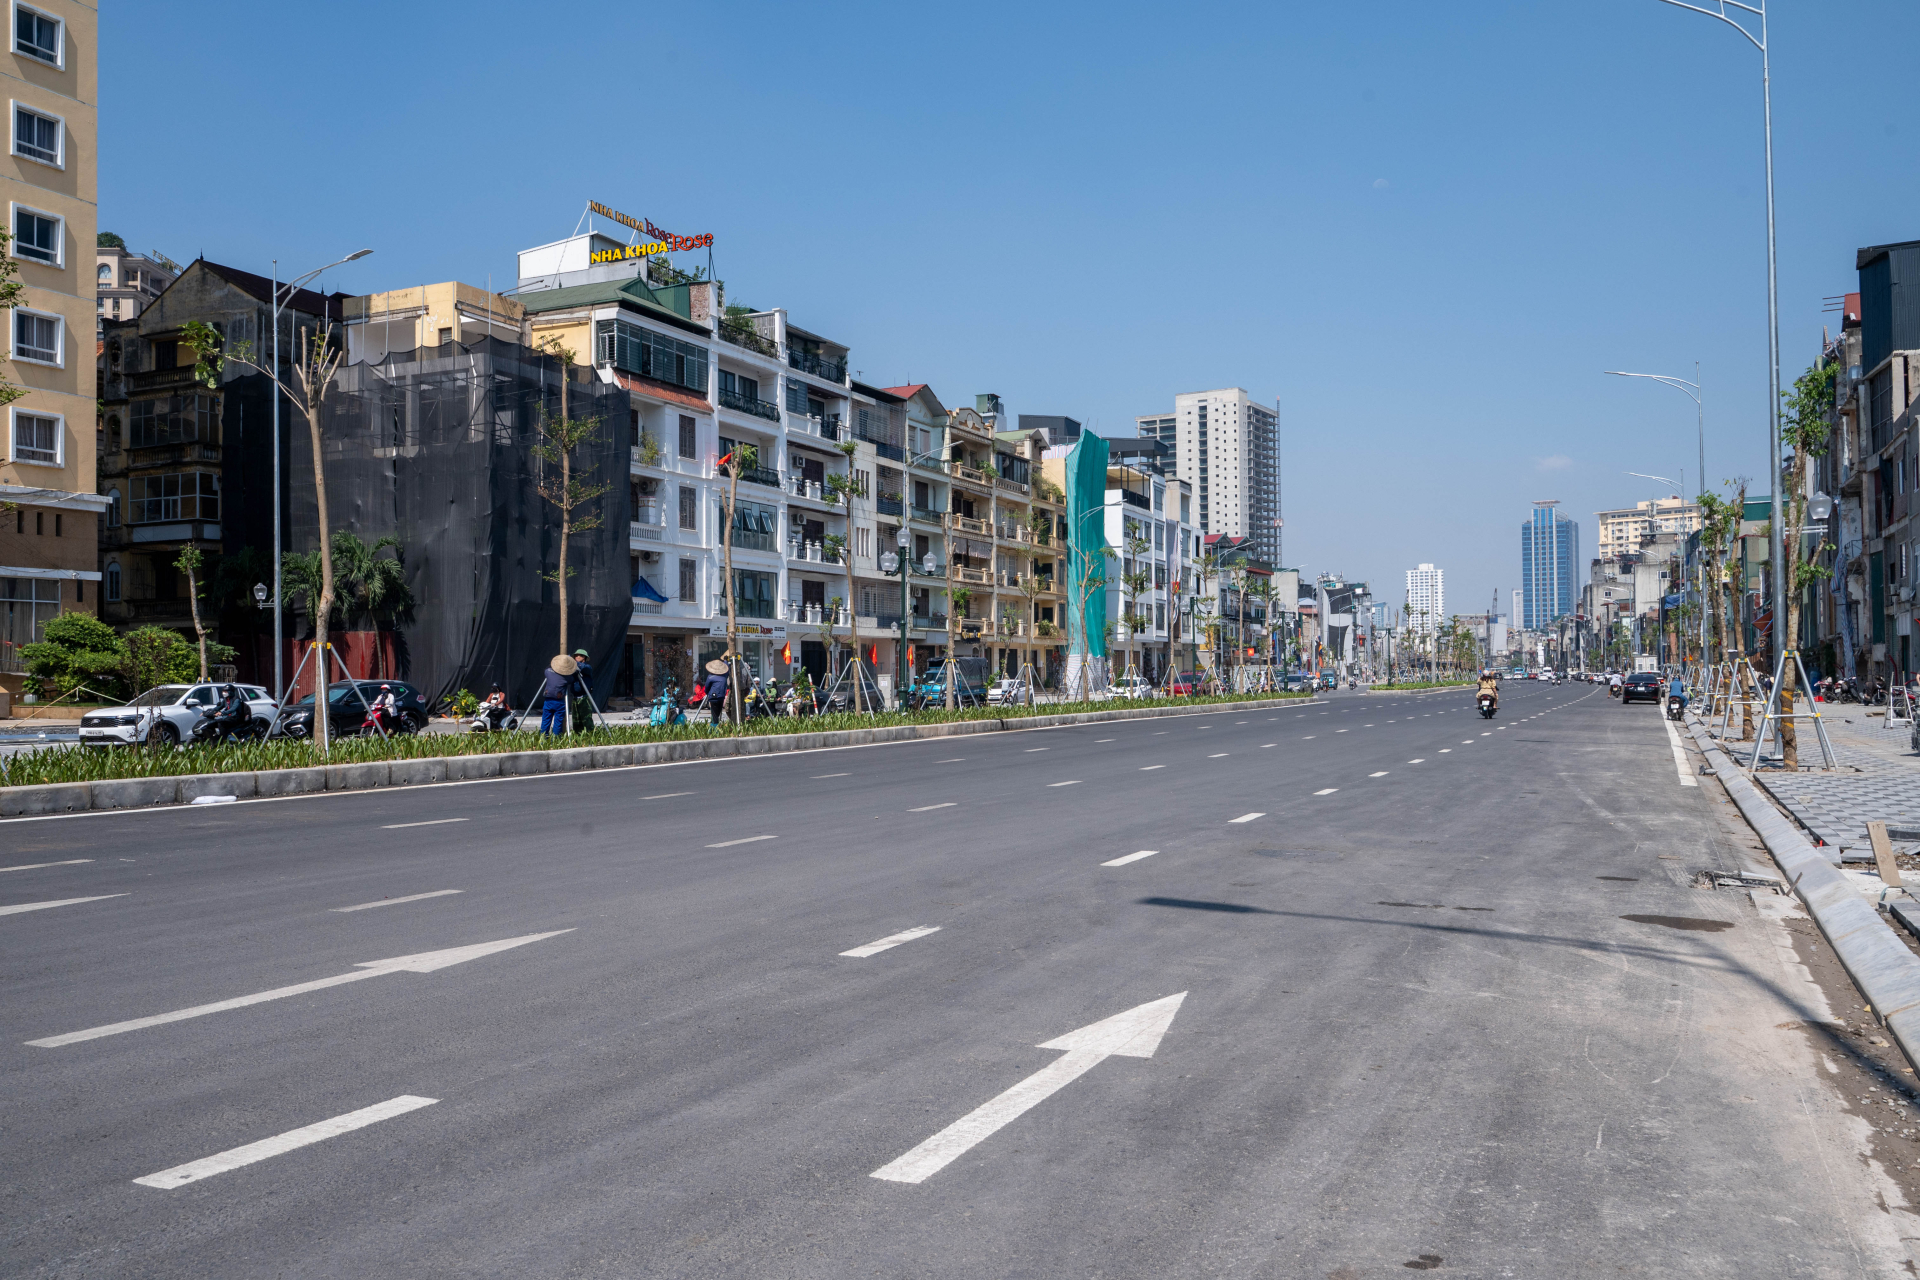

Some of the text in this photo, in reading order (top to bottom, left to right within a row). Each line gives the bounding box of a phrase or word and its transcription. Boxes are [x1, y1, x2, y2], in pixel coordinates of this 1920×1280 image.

[591, 200, 673, 244] NHA KHOA Rose
[591, 233, 713, 264] NHA KHOA Rose
[742, 625, 760, 634] KHOA
